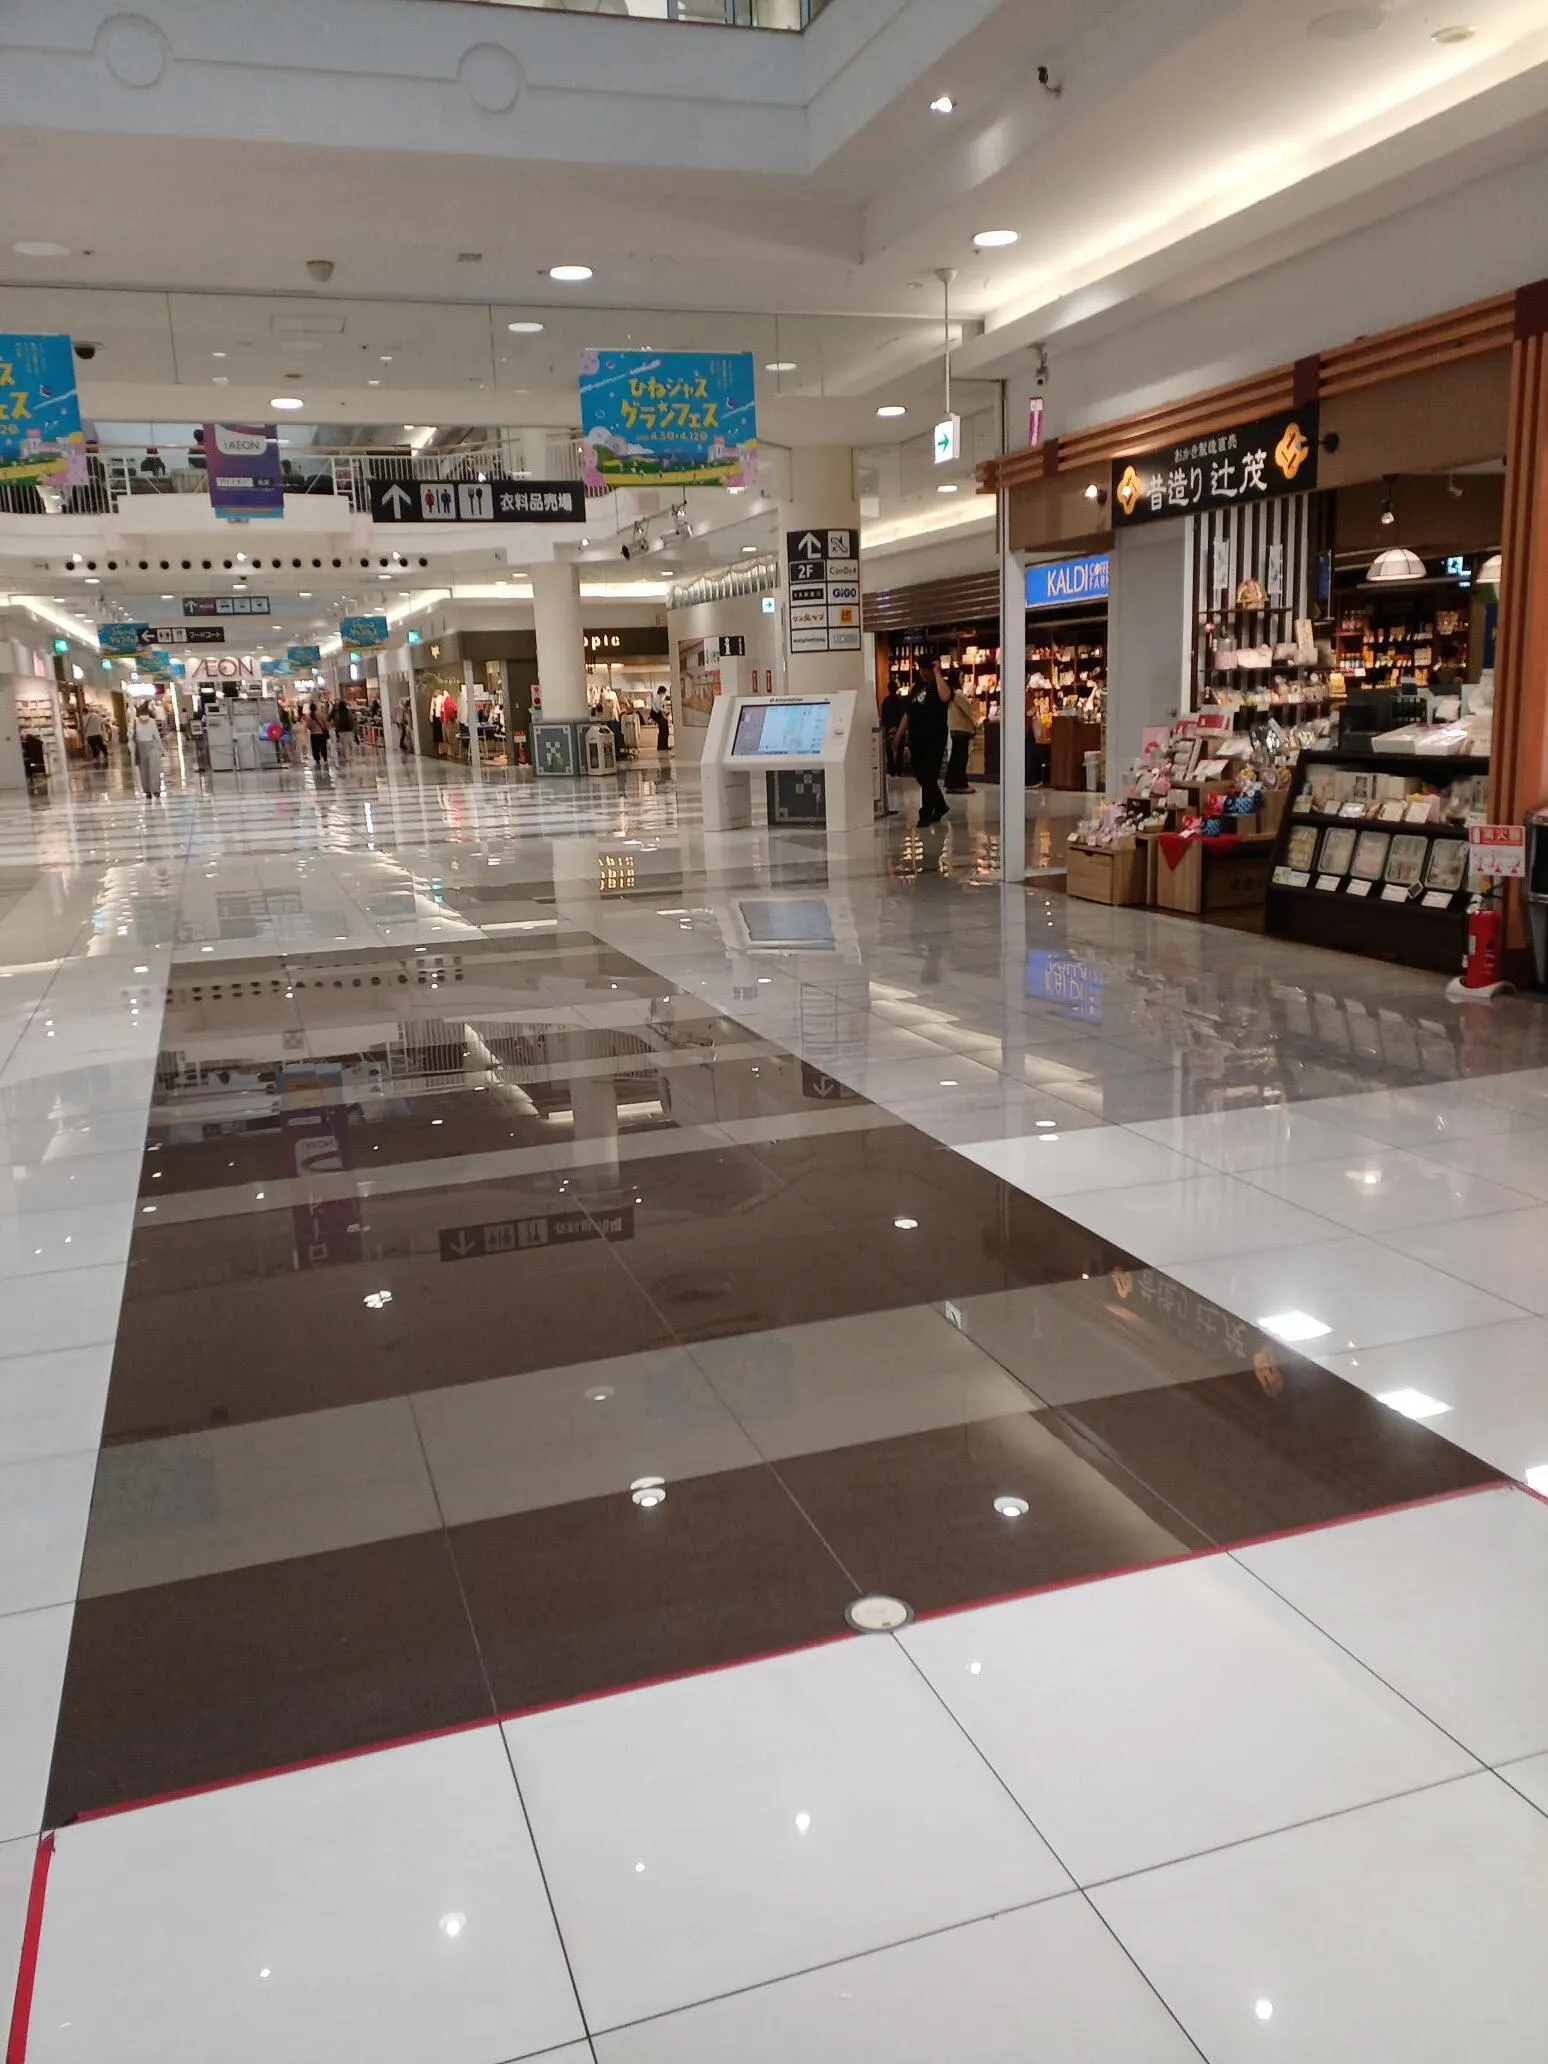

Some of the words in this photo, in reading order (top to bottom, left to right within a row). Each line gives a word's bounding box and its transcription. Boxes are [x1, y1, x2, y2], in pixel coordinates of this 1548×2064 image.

[621, 399, 718, 430] グランフェス
[500, 492, 573, 513] 衣料品売場
[798, 564, 814, 579] 2F
[1047, 564, 1088, 597] KALDI
